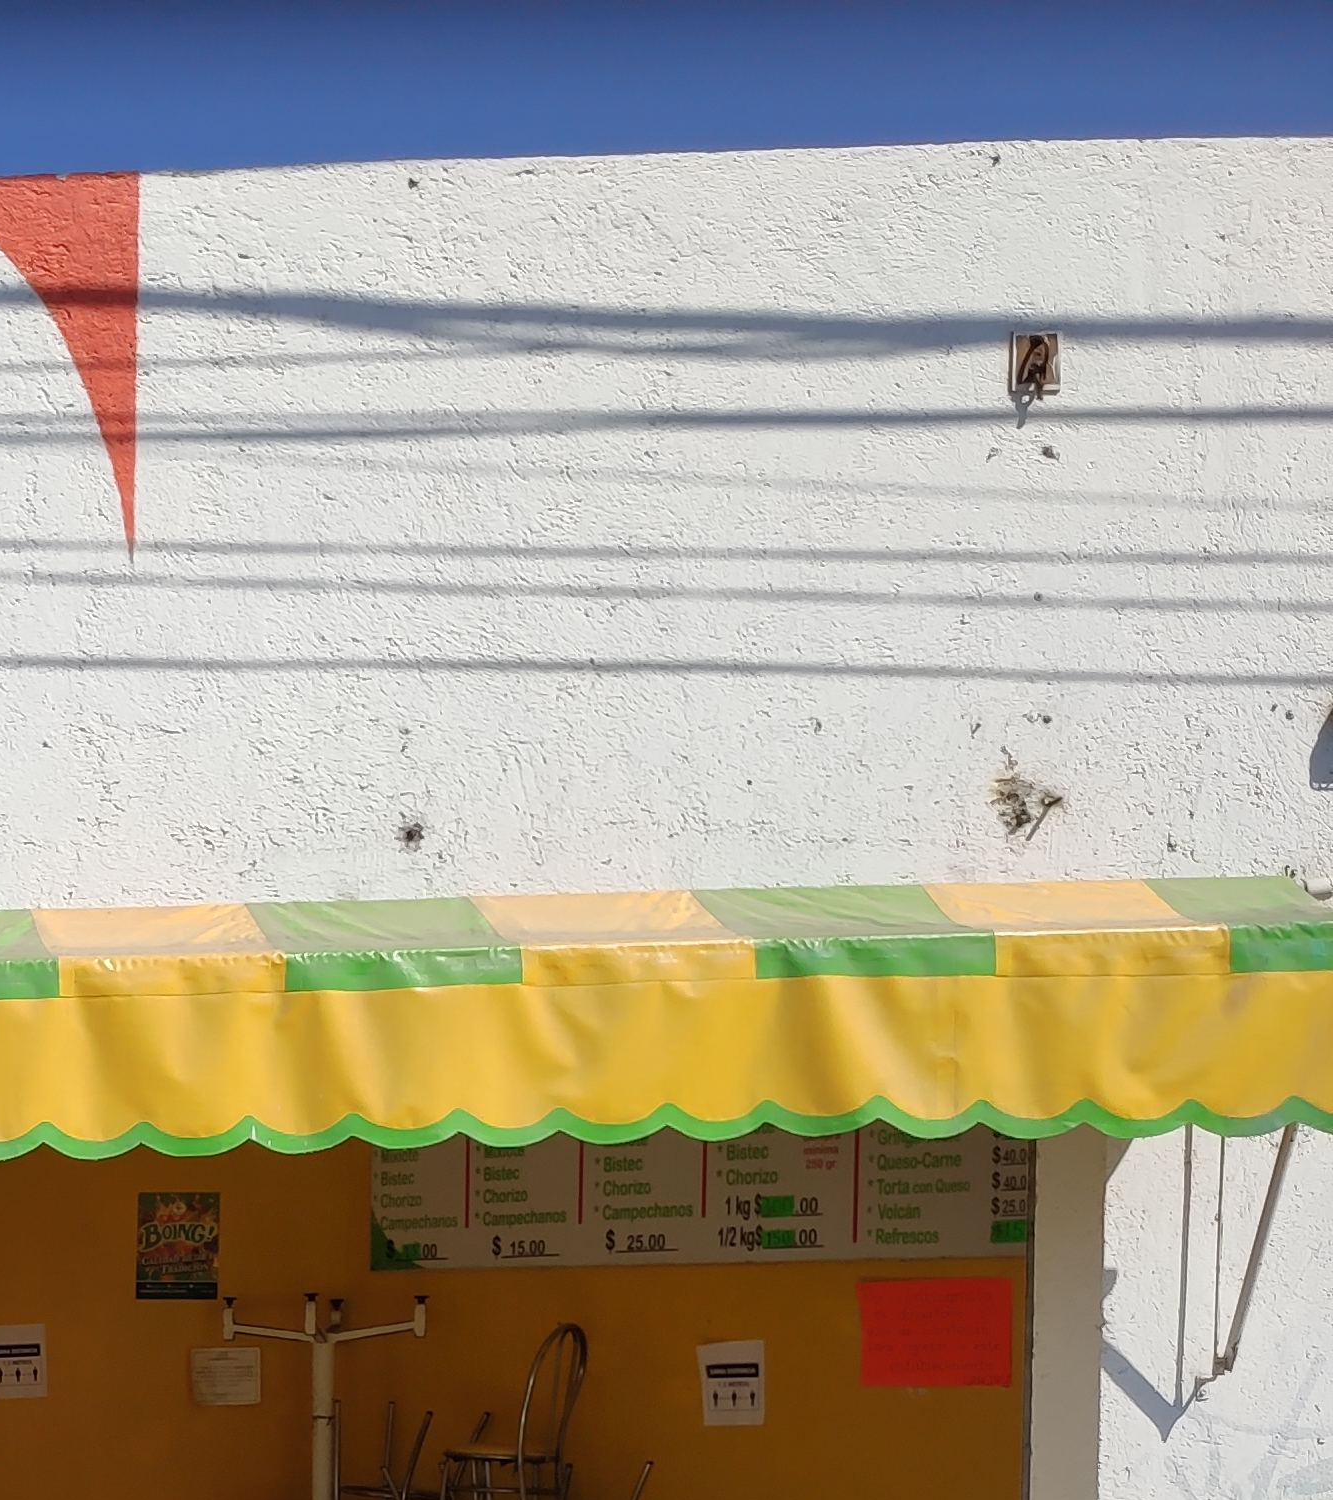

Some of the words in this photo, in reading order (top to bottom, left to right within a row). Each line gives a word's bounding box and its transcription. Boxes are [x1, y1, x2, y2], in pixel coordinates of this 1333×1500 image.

[727, 1144, 768, 1161] Bistec
[603, 1157, 642, 1173] Bistec
[877, 1152, 962, 1171] Queso-Carne
[380, 1171, 414, 1186] Bistec
[483, 1167, 520, 1181] Bistec
[726, 1169, 777, 1186] Chorizo
[603, 1181, 651, 1197] Chorizo
[877, 1179, 910, 1195] Torta
[380, 1193, 422, 1208] Chorizo
[483, 1189, 528, 1204] Chorizo
[603, 1203, 693, 1222] Campechanos
[726, 1197, 732, 1215] 1
[736, 1196, 751, 1220] kg
[380, 1215, 458, 1232] Campechanos
[483, 1209, 567, 1228] Campechanos
[140, 1222, 216, 1250] BOING!
[627, 1234, 666, 1251] 25.00
[718, 1226, 736, 1247] 1/2
[876, 1228, 940, 1245] Refrescos
[510, 1240, 545, 1255] 15.00
